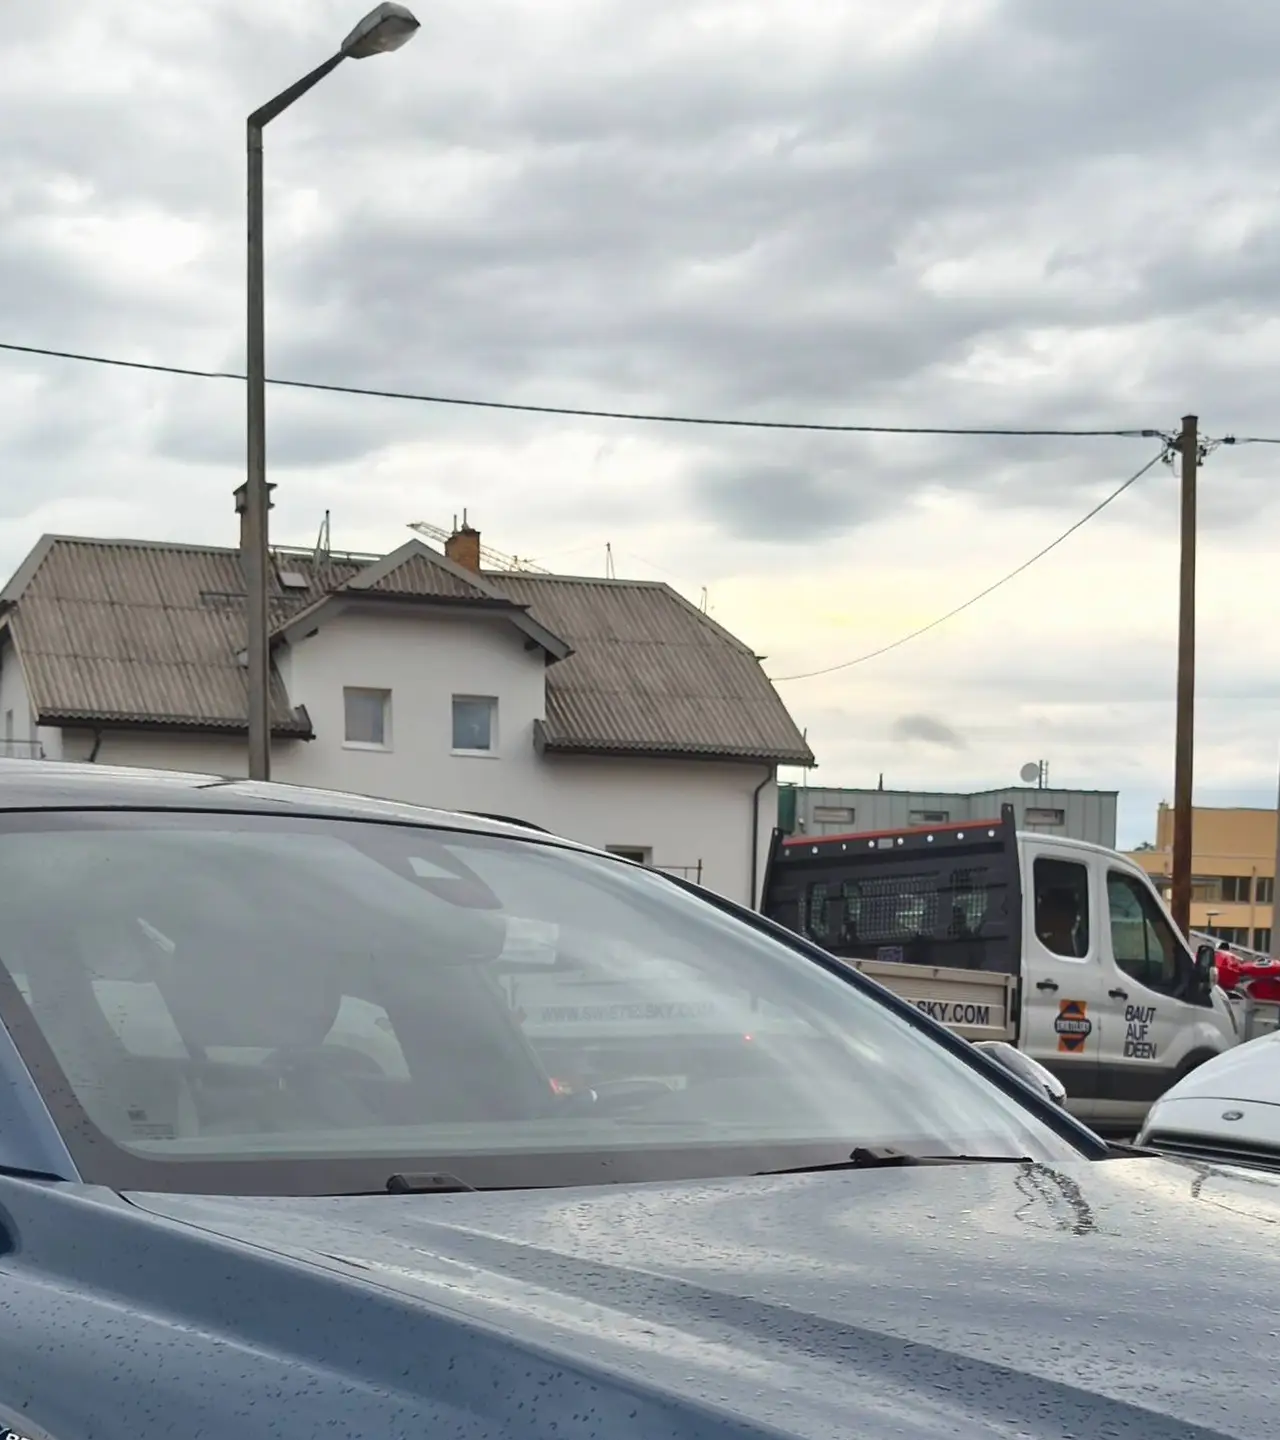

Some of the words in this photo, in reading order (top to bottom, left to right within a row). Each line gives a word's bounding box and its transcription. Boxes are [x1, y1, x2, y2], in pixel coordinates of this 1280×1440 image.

[907, 1000, 989, 1024] SKY.COM
[1125, 1005, 1156, 1023] BAUT
[1125, 1024, 1148, 1040] AUF
[1123, 1041, 1157, 1058] IDEEN
